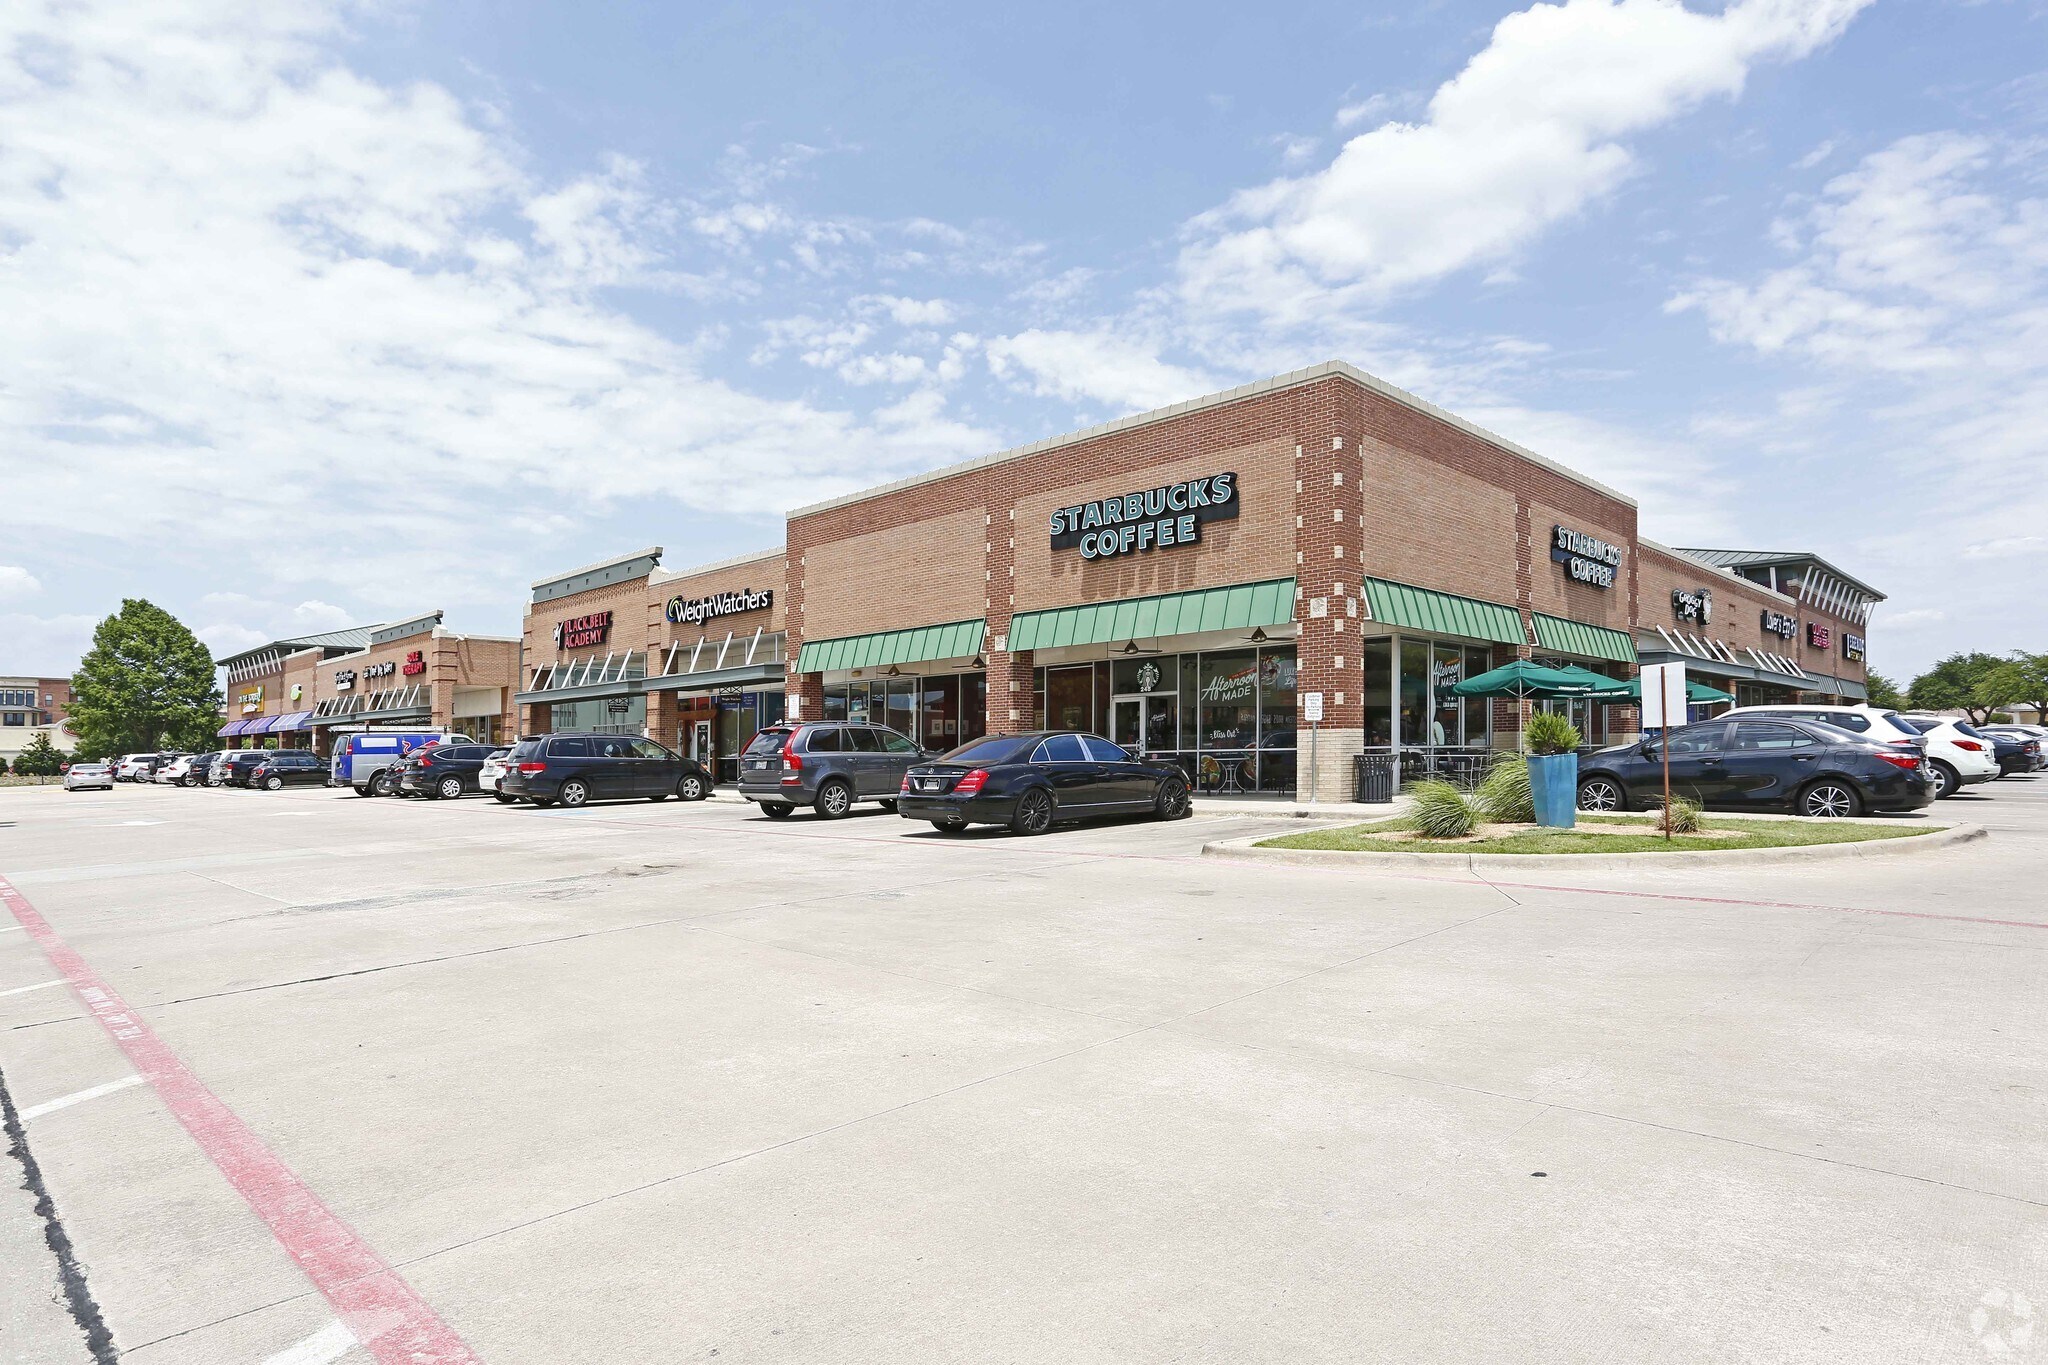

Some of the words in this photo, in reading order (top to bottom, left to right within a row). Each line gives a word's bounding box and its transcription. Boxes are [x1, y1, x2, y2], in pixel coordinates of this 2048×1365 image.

[1049, 475, 1232, 536] STARBUCKS
[1079, 514, 1196, 559] COFFEE
[1558, 526, 1622, 567] STARBUCKS
[1571, 556, 1612, 588] COFFEE
[675, 589, 768, 626] WeightWatchers
[1679, 591, 1702, 608] GROGGY
[1684, 604, 1697, 618] DOG
[564, 617, 588, 634] BLACK
[589, 612, 608, 629] BELT
[565, 629, 602, 648] ACADEMY
[1201, 672, 1258, 701] Afternoon
[1222, 685, 1251, 701] MADE
